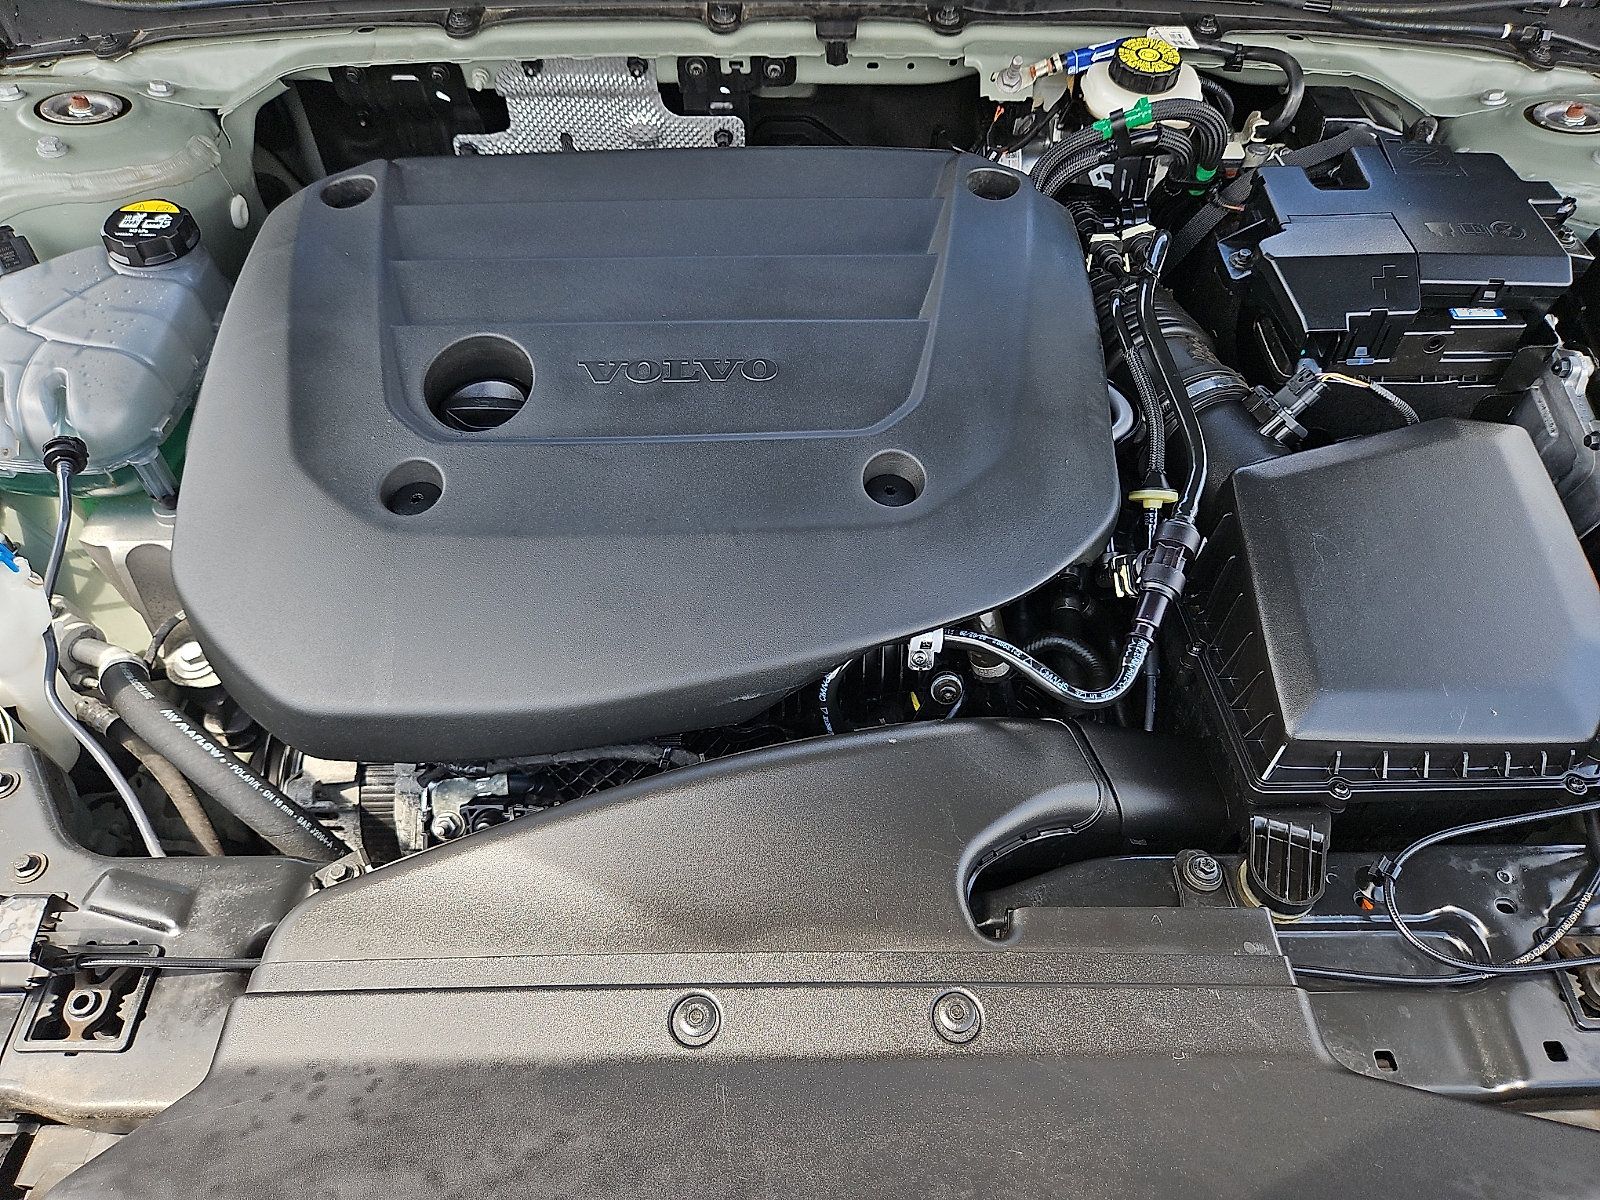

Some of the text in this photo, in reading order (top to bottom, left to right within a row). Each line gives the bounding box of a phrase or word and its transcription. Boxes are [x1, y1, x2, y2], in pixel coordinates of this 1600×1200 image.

[577, 358, 779, 384] VOLVO
[175, 722, 226, 758] MAFLOW
[281, 804, 295, 818] mm
[1578, 892, 1593, 911] VOLVO
